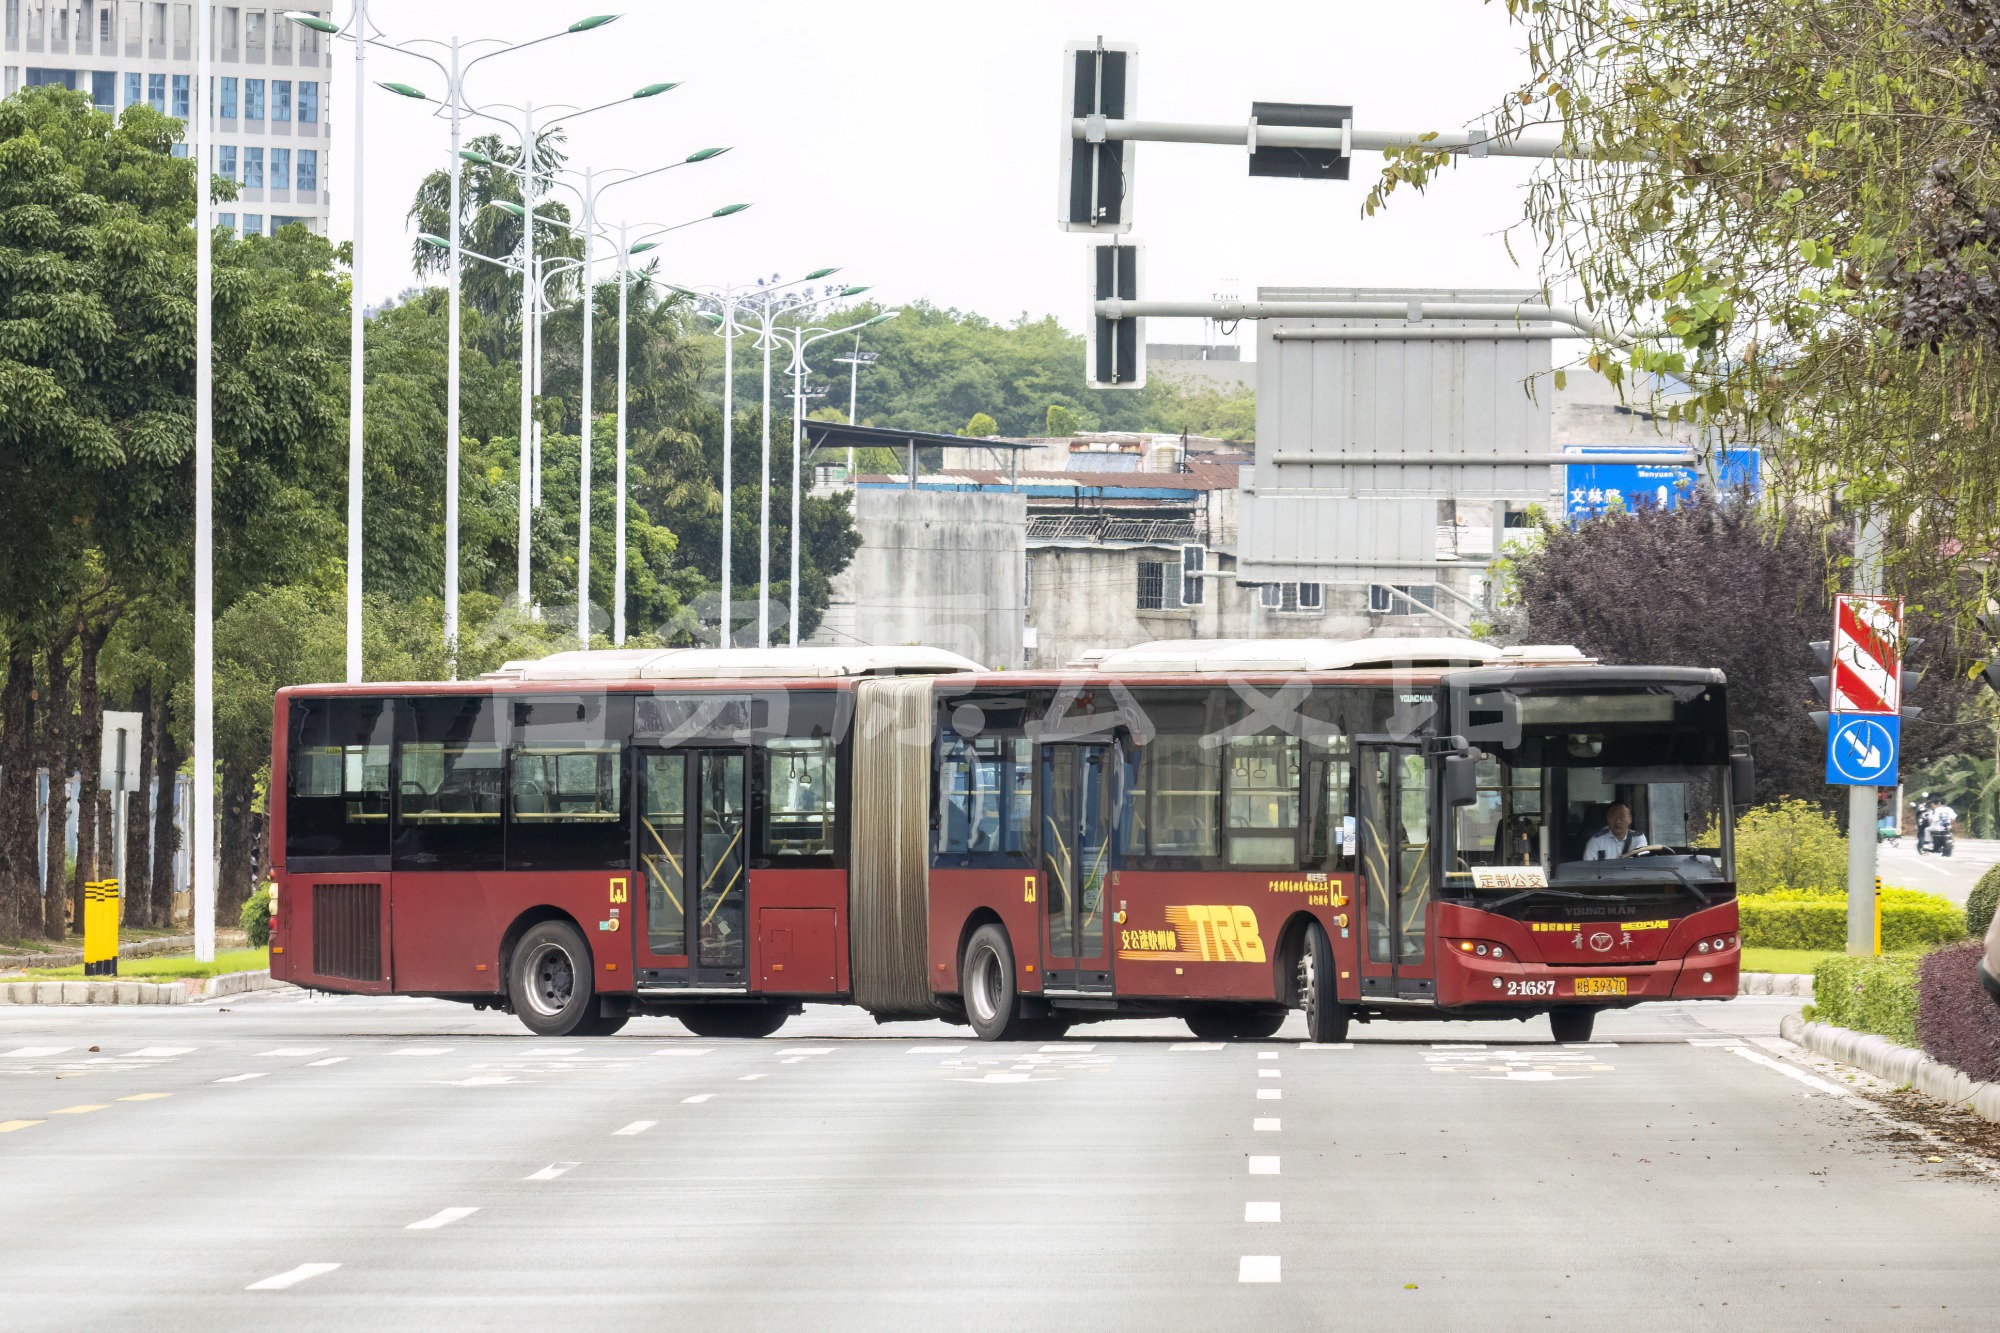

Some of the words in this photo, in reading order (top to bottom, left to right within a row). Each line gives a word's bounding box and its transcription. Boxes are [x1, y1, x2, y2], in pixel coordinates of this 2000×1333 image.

[1479, 873, 1543, 888] 定制公交
[1187, 905, 1266, 962] TRB
[1507, 981, 1556, 996] 2-1687
